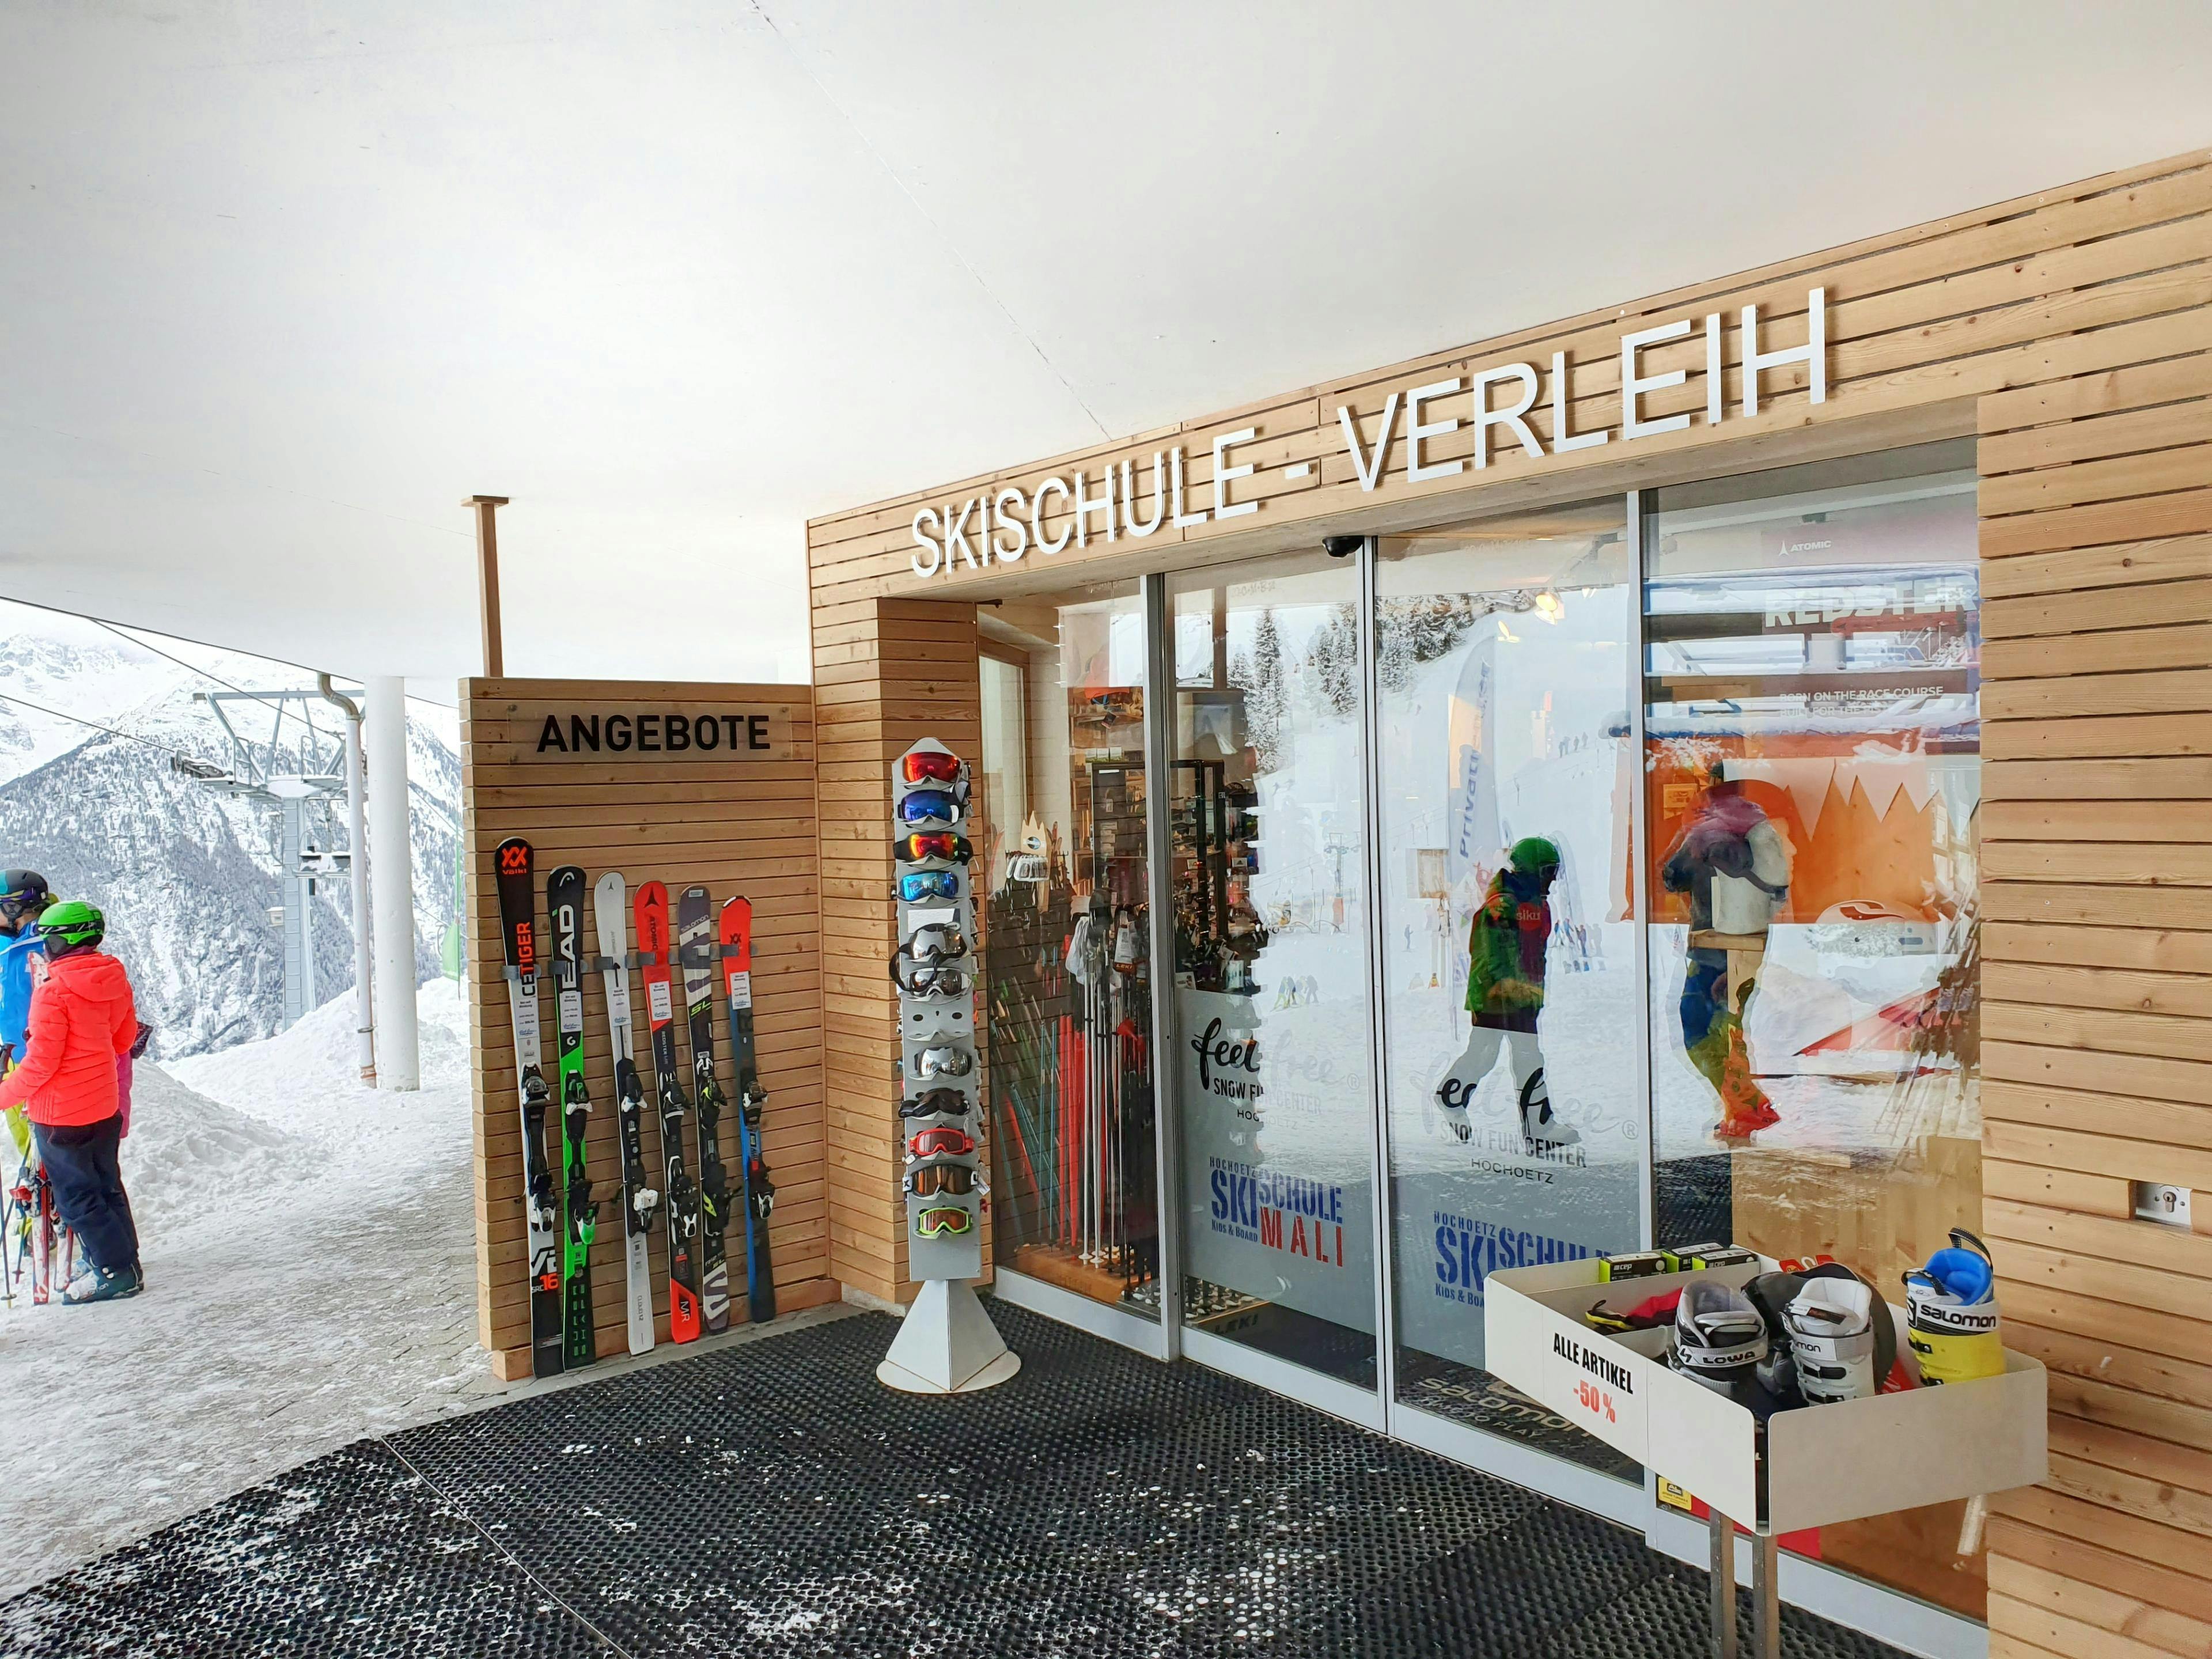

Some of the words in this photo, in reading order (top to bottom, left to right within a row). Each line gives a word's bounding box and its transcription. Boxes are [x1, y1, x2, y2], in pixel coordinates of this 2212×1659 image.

[911, 426, 1259, 578] SKISCHULE
[1337, 286, 1826, 491] VERLEIH
[1790, 540, 1832, 553] ATOMIC
[1764, 576, 1978, 628] REDSTER
[1814, 691, 1832, 702] ON
[1835, 689, 1857, 700] THE
[1859, 687, 1891, 699] RACE
[1894, 685, 1944, 698] COURSE
[537, 714, 771, 752] ANGEBOTE
[1516, 910, 1541, 921] siku
[650, 916, 658, 950] ATOMIC
[559, 904, 578, 989] EAD
[516, 922, 536, 998] CETIGER
[1214, 1077, 1245, 1100] SNOW
[1525, 1136, 1588, 1168] CENTER
[1210, 1156, 1257, 1178] HOCHOETZ
[1471, 1158, 1554, 1184] HOCHOETZ
[1260, 1206, 1343, 1267] MALI
[1434, 1211, 1497, 1237] HOCHOETZ
[540, 1272, 559, 1291] 16
[680, 1300, 691, 1323] MR
[1703, 1350, 1756, 1364] LOWA
[1795, 1341, 1821, 1353] mon
[1553, 1332, 1580, 1365] ALLE
[1582, 1347, 1634, 1395] ARTIKEL
[1573, 1379, 1600, 1413] -50
[1493, 1421, 1543, 1438] PLAY
